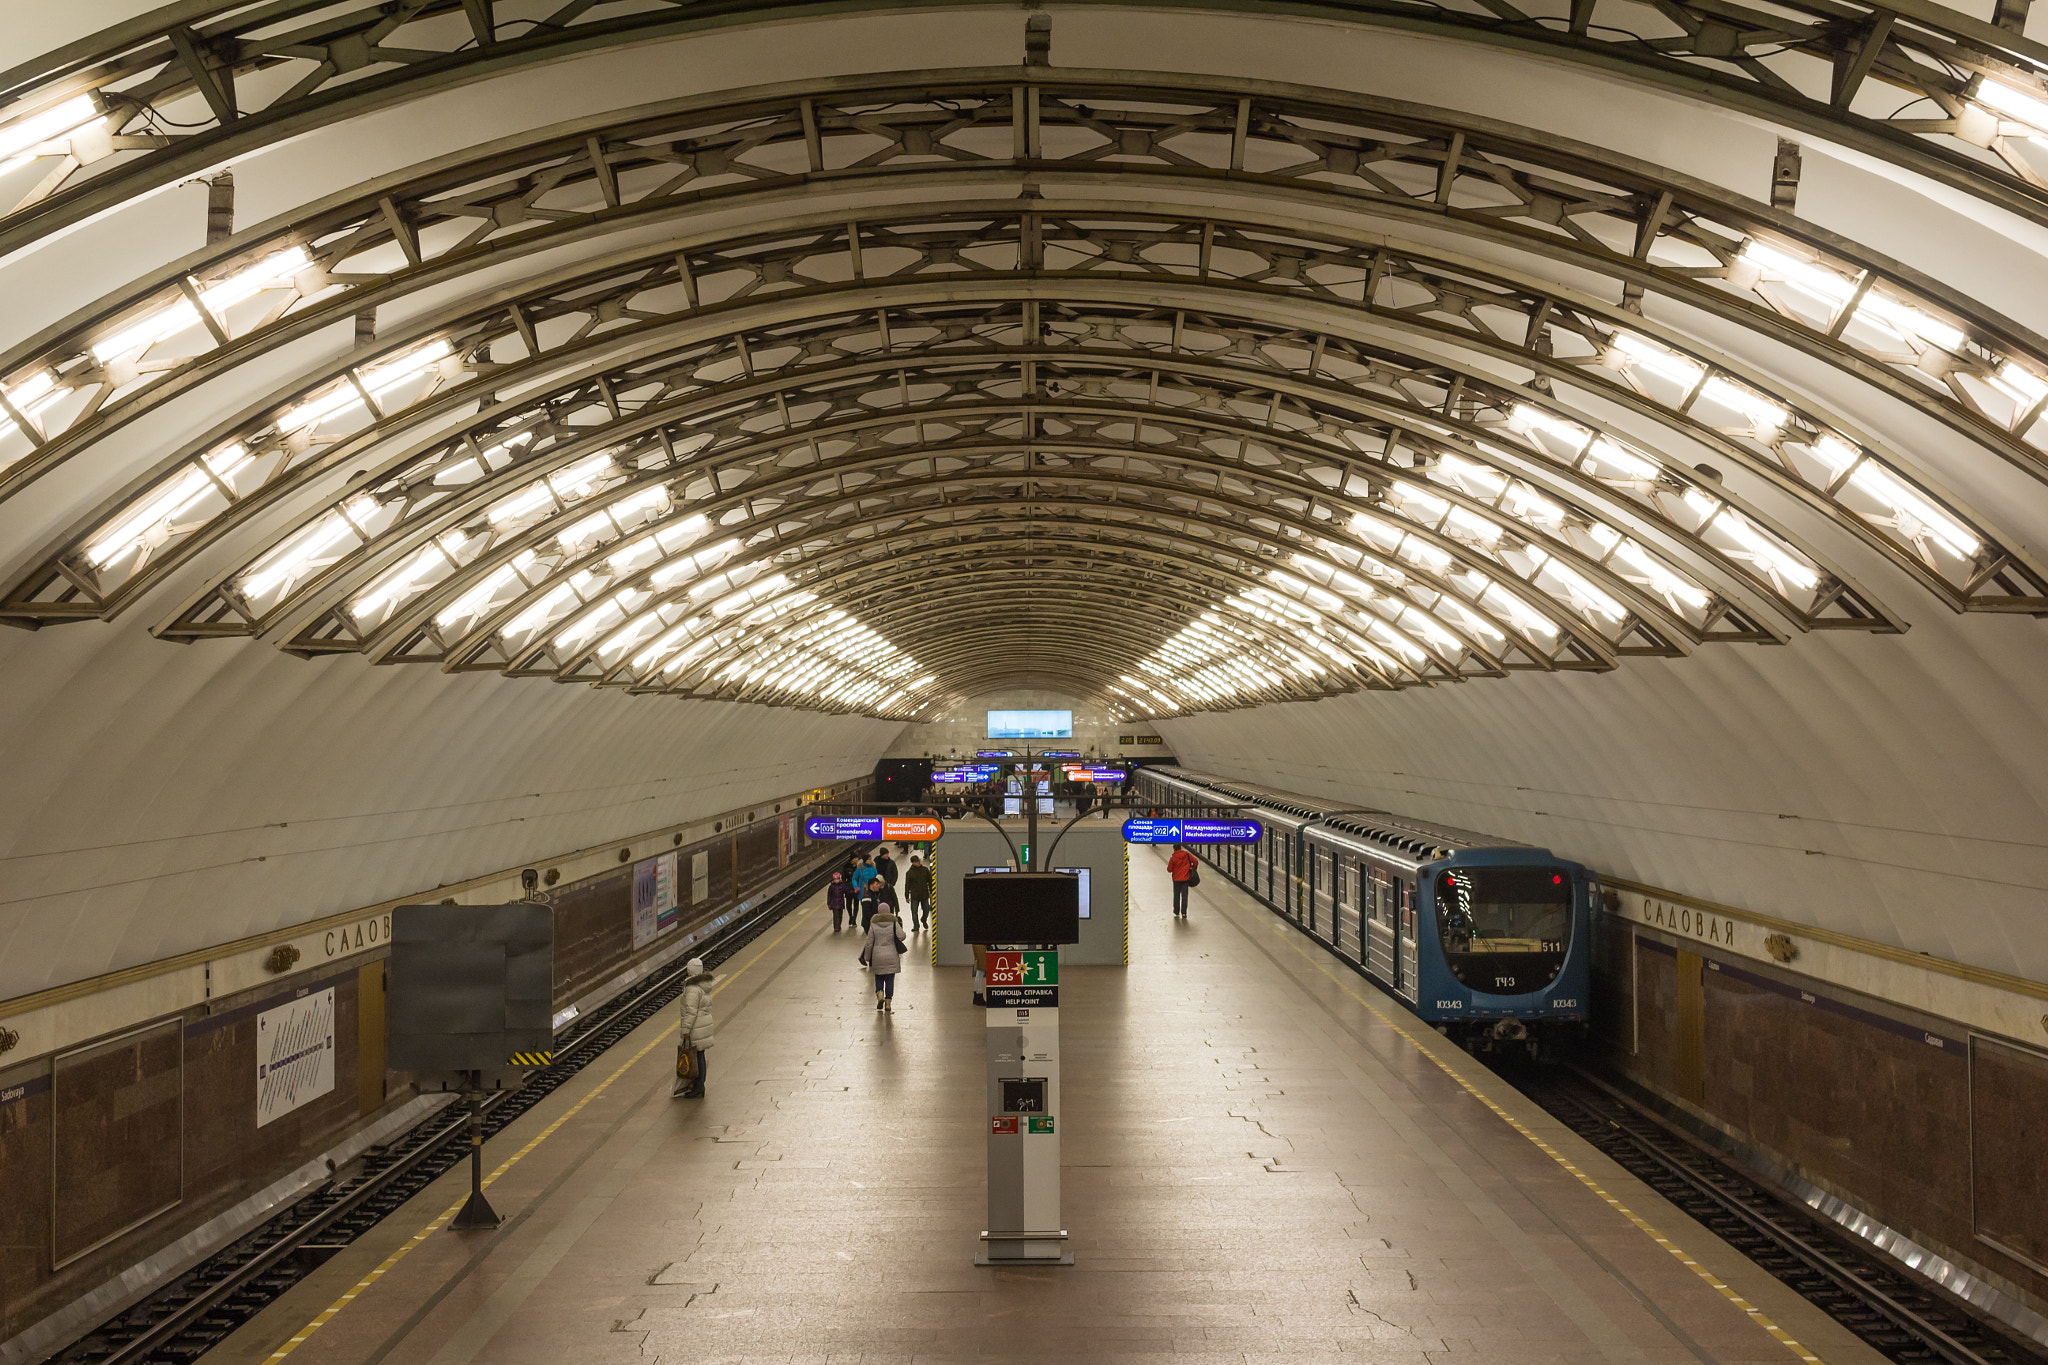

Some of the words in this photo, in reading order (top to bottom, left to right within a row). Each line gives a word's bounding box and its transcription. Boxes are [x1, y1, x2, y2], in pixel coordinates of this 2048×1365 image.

[1644, 899, 1733, 946] САДОВАЯ
[325, 916, 390, 956] САДОВ
[1542, 942, 1560, 952] 511
[992, 972, 1014, 981] SOS
[1437, 1000, 1463, 1009] 10343
[1553, 999, 1577, 1009] 10343
